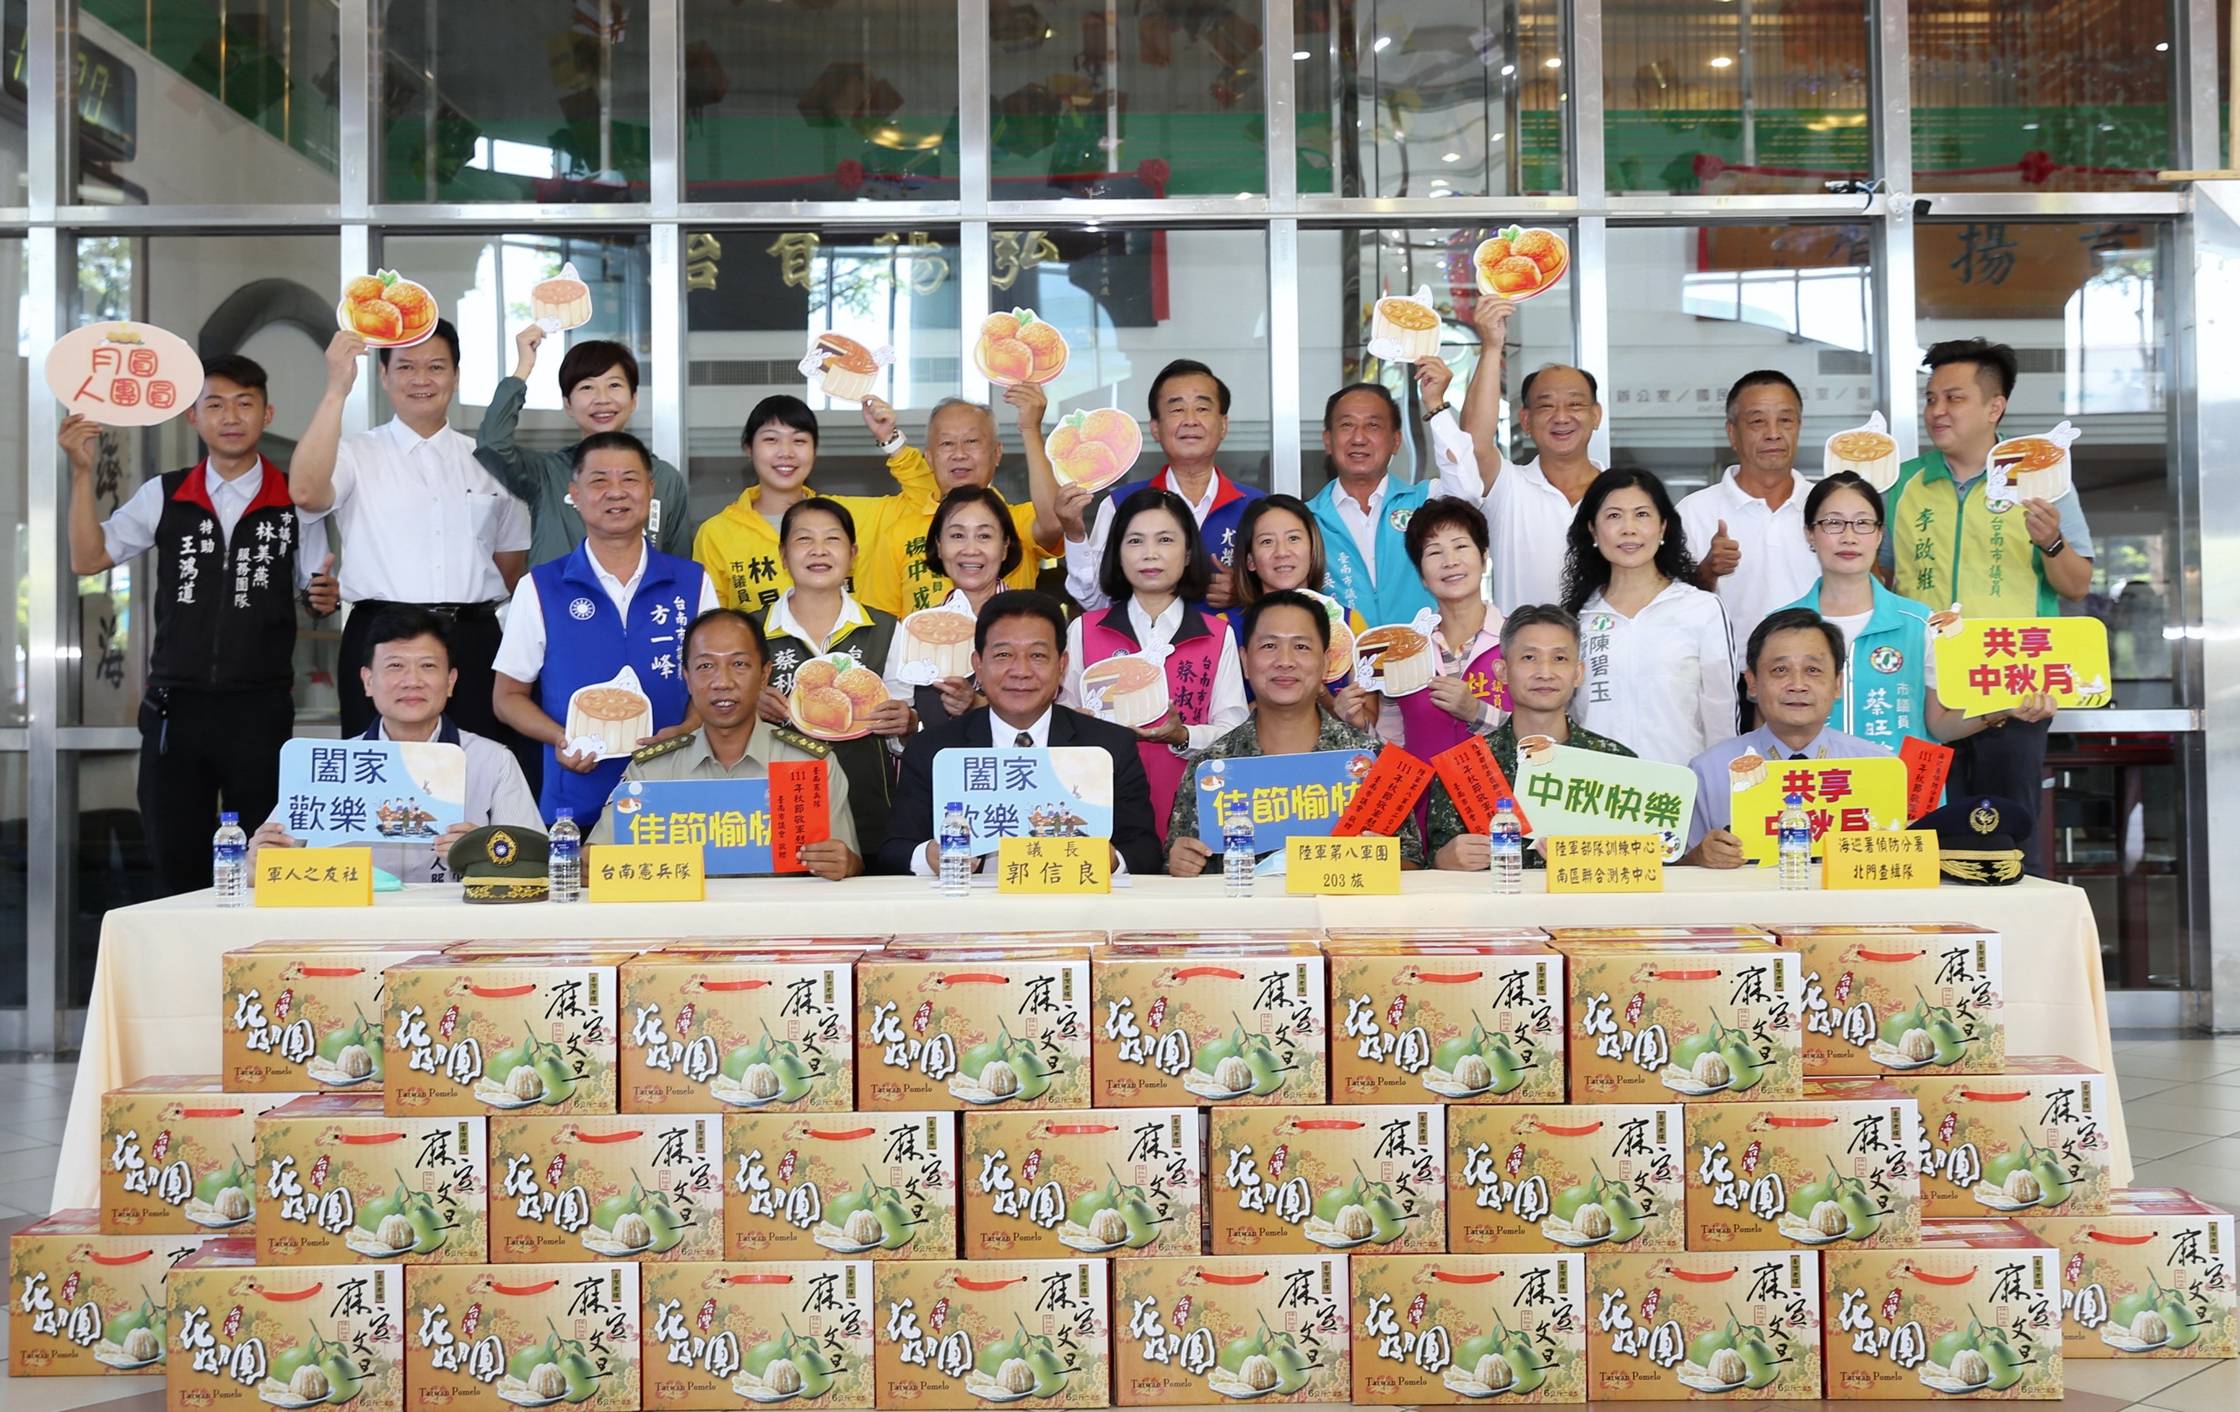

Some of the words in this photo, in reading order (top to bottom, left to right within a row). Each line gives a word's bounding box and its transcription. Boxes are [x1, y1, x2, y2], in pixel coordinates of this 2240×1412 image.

[92, 347, 159, 378] 月圓
[74, 375, 177, 410] 人團圓
[199, 519, 215, 553] 特助
[176, 535, 199, 604] 王鴻道
[252, 521, 278, 590] 林美燕
[1989, 516, 2005, 598] 台南市議員
[234, 548, 251, 609] 服務團隊
[730, 561, 753, 605] 市議員
[650, 604, 677, 680] 方一峰
[1983, 627, 2053, 659] 共享
[1589, 634, 1612, 703] 陳碧玉
[1969, 664, 2073, 697] 中秋月
[1896, 682, 1911, 729] 市議員
[311, 747, 389, 785] 闔家
[963, 755, 1038, 792] 闔家
[1527, 771, 1683, 829] 中秋快樂
[1781, 768, 1852, 804] 共享
[287, 794, 368, 833] 歡樂
[1026, 841, 1081, 858] 議長
[1299, 844, 1389, 862] 陸軍第八軍團
[1555, 839, 1656, 857] 陸軍部隊訓練中心
[1838, 836, 1925, 854] 海巡署偵防分署
[266, 865, 360, 884] 軍人之友社
[600, 862, 691, 881] 台南憲兵隊
[1006, 861, 1099, 886] 郭信良
[1323, 874, 1346, 888] 203
[1350, 872, 1365, 888] 旅
[1556, 867, 1657, 885] 南區聯合測考中心
[1853, 864, 1914, 881] 北門查緝隊
[439, 1008, 458, 1037] 台灣
[676, 1005, 694, 1034] 台灣
[913, 1003, 931, 1032] 台灣
[1148, 999, 1166, 1028] 台灣
[1387, 997, 1405, 1026] 台灣
[1626, 994, 1644, 1023] 台灣
[396, 1089, 428, 1099] Taiwan
[428, 1087, 459, 1099] Pomelo
[633, 1086, 665, 1097] Taiwan
[665, 1085, 696, 1096] Pomelo
[871, 1084, 902, 1095] Taiwan
[903, 1083, 934, 1094] Pomelo
[1106, 1080, 1137, 1090] Taiwan
[1138, 1078, 1169, 1090] Pomelo
[1345, 1077, 1376, 1088] Taiwan
[1377, 1076, 1408, 1088] Pomelo
[1584, 1075, 1615, 1086] Taiwan
[1616, 1074, 1647, 1086] Pomelo
[311, 1157, 329, 1186] 台灣
[778, 1152, 796, 1181] 台灣
[1022, 1151, 1040, 1180] 台灣
[1268, 1147, 1286, 1176] 台灣
[1742, 1143, 1760, 1172] 台灣
[268, 1238, 300, 1248] Taiwan
[300, 1236, 331, 1248] Pomelo
[736, 1232, 768, 1243] Taiwan
[768, 1231, 799, 1243] Pomelo
[980, 1233, 1012, 1243] Taiwan
[1012, 1231, 1043, 1243] Pomelo
[1226, 1228, 1258, 1238] Taiwan
[1258, 1226, 1289, 1238] Pomelo
[1700, 1224, 1732, 1235] Taiwan
[1732, 1223, 1763, 1234] Pomelo
[697, 1301, 715, 1330] 台灣
[1172, 1298, 1190, 1326] 台灣
[1641, 1290, 1659, 1319] 台灣
[1882, 1290, 1900, 1320] 台灣
[223, 1308, 242, 1337] 台灣
[655, 1382, 686, 1392] Taiwan
[687, 1381, 718, 1392] Pomelo
[1130, 1379, 1162, 1390] Taiwan
[1162, 1378, 1194, 1389] Pomelo
[1600, 1372, 1631, 1382] Taiwan
[1631, 1370, 1662, 1382] Pomelo
[1840, 1372, 1872, 1382] Taiwan
[1872, 1371, 1904, 1383] Pomelo
[180, 1390, 212, 1401] Taiwan
[212, 1388, 244, 1400] Pomelo
